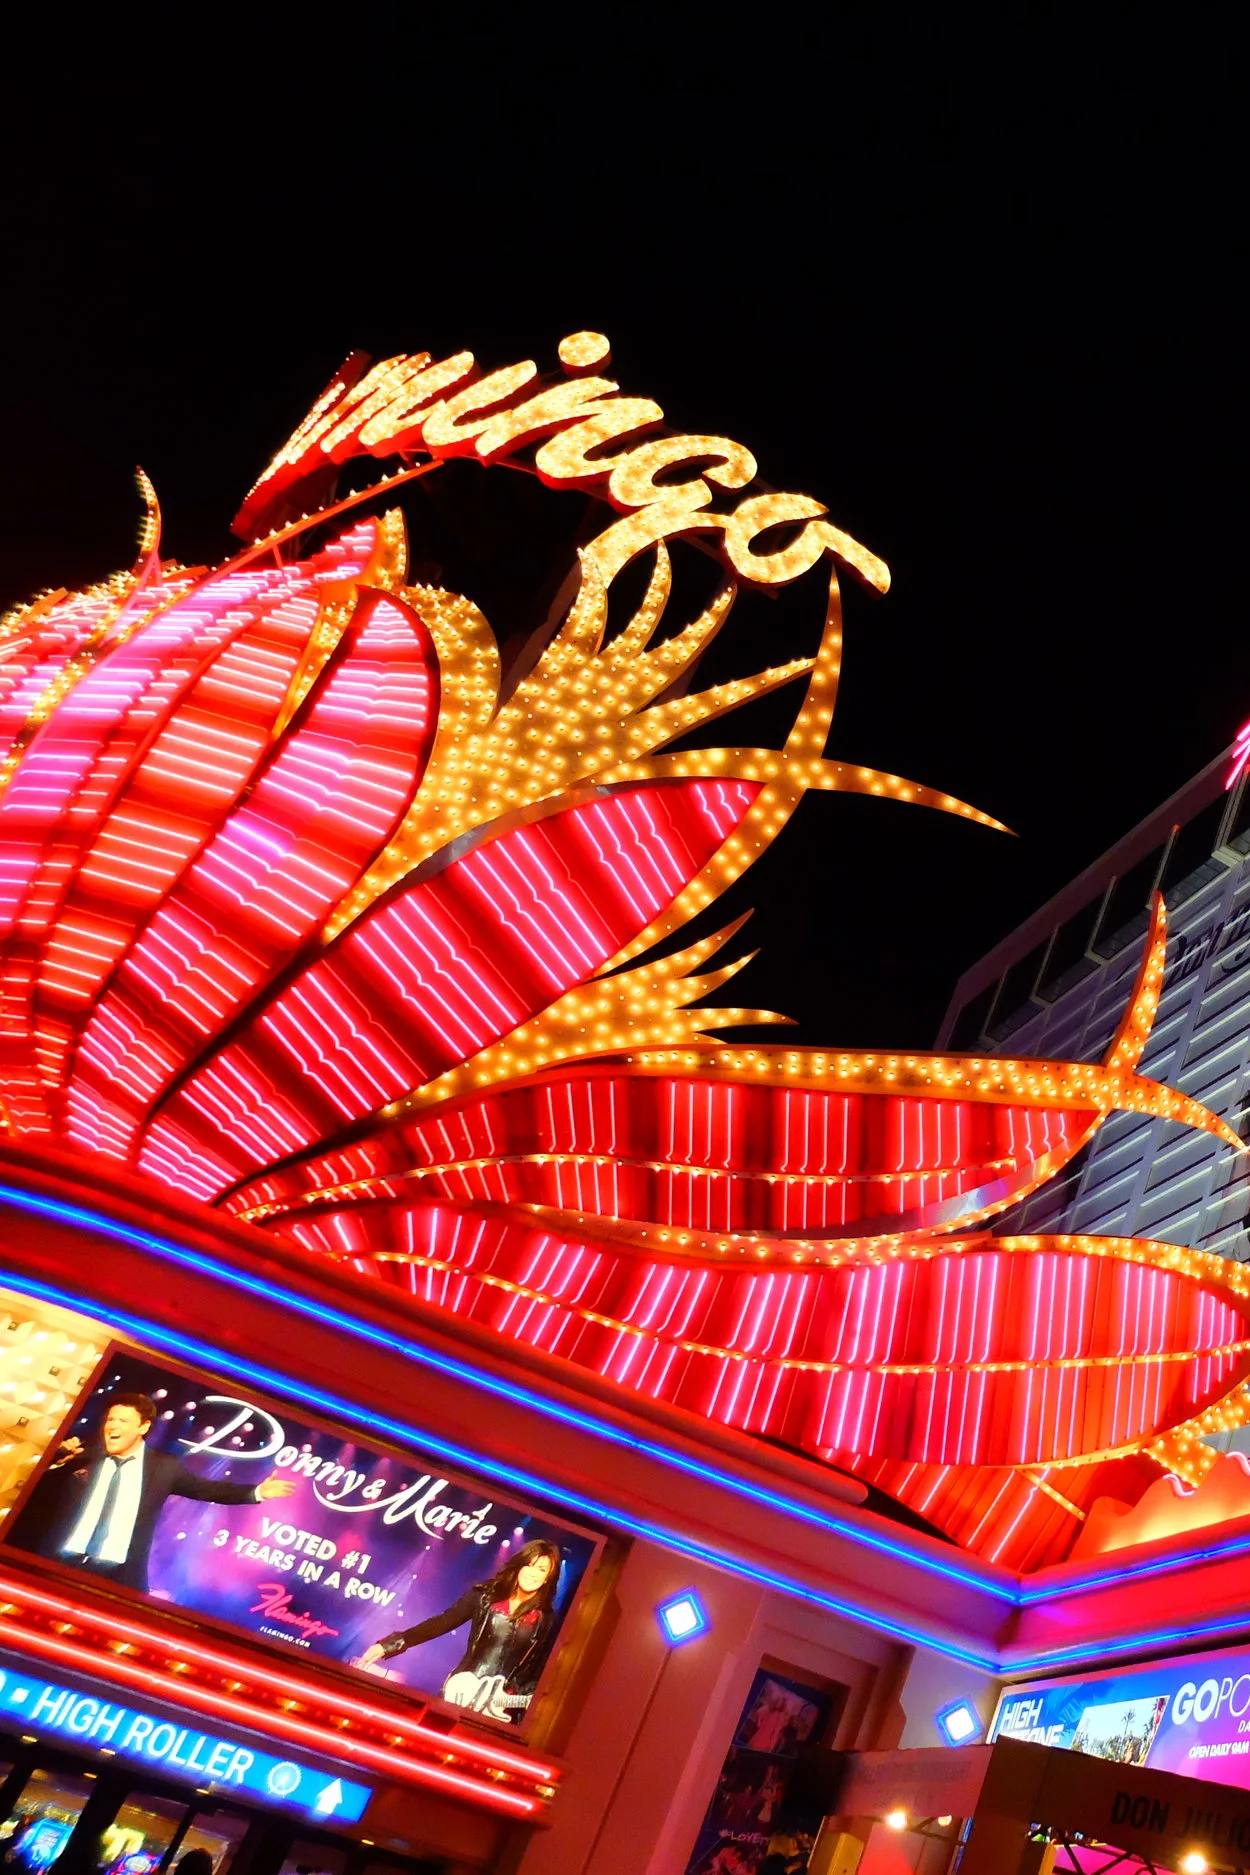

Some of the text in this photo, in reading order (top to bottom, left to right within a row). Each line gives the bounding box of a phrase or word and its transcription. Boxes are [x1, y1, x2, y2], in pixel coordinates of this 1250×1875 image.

[177, 1395, 498, 1545] Donny & Marie
[213, 1529, 398, 1608] 3 YEARS IN A ROW
[261, 1516, 373, 1575] VOTED #1
[248, 1582, 341, 1640] Flamingo
[259, 1626, 312, 1649] FLAMINGO.COM
[31, 1686, 256, 1785] HIGH ROLLER
[1000, 1697, 1044, 1732] HIGH
[1188, 1745, 1211, 1760] OPEN
[1209, 1742, 1232, 1758] DAILY
[1109, 1790, 1170, 1835] DON
